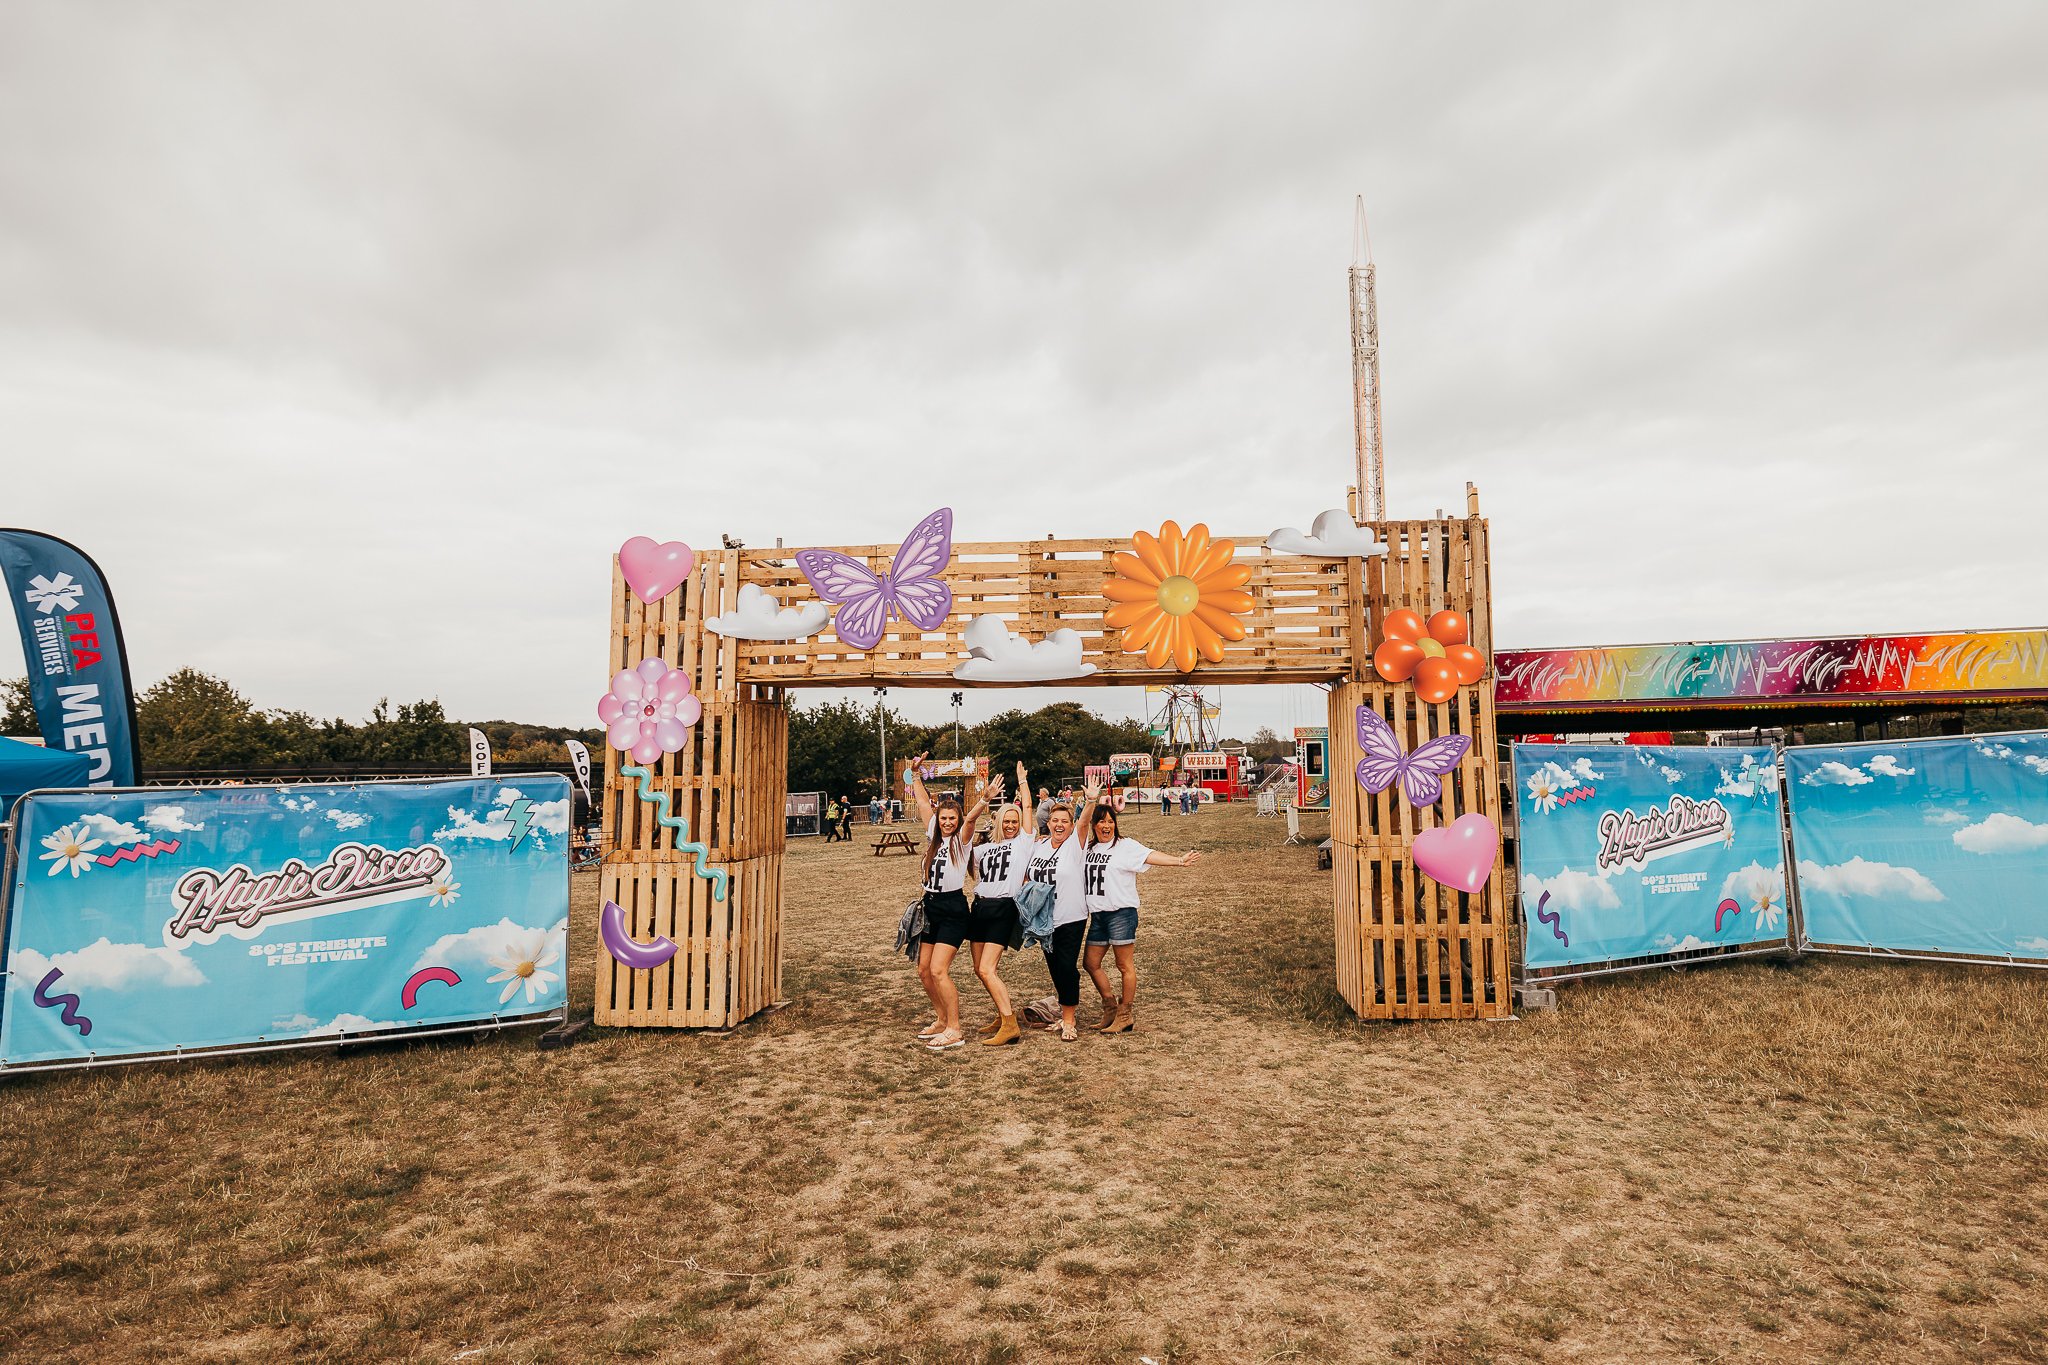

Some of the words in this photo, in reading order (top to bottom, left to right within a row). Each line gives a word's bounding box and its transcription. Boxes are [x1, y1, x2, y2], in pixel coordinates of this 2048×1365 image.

[33, 617, 65, 676] SERVICES
[65, 612, 103, 671] PFA
[1187, 756, 1224, 766] WHEEL
[1600, 808, 1666, 869] Magic
[1666, 797, 1726, 839] Disco
[1086, 853, 1113, 864] OOSE
[928, 859, 947, 892] FE
[1085, 864, 1107, 897] IFE
[1641, 875, 1666, 886] 80'S
[1666, 872, 1708, 884] TRIBUTE
[1651, 882, 1700, 894] FESTIVAL
[171, 862, 312, 938] Magic
[312, 846, 446, 897] Disco
[249, 942, 296, 956] 80'S
[299, 936, 387, 953] TRIBUTE
[267, 949, 368, 967] FESTIVAL
